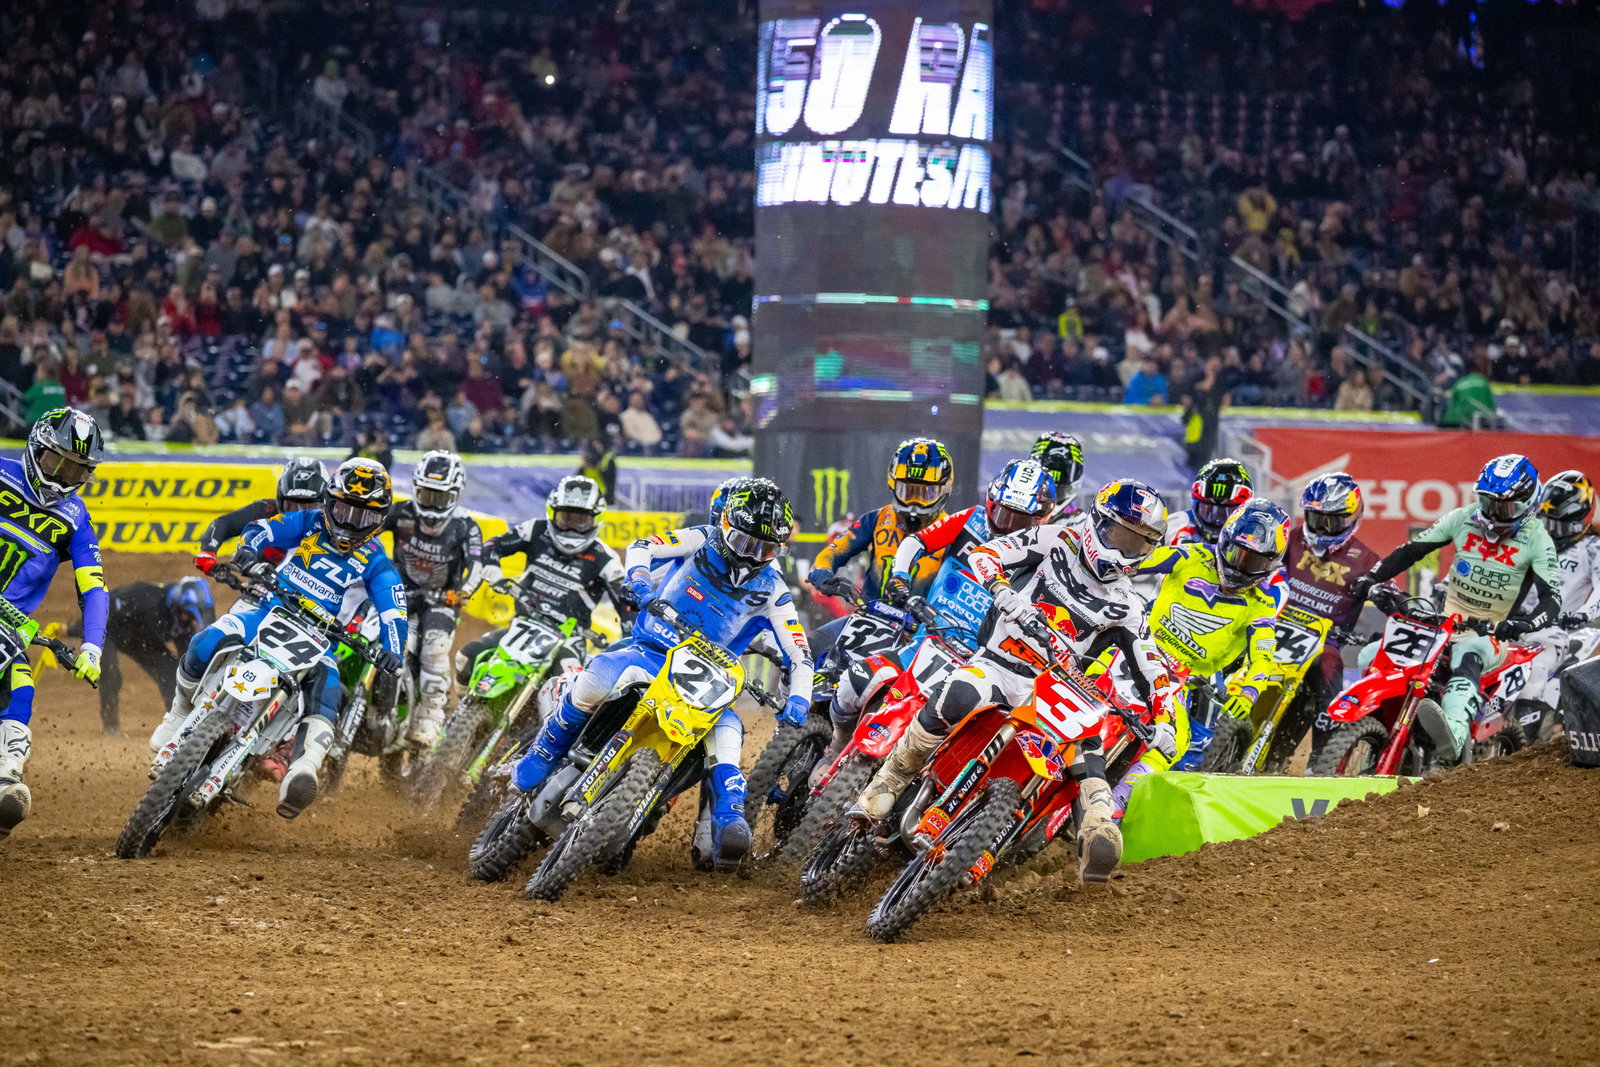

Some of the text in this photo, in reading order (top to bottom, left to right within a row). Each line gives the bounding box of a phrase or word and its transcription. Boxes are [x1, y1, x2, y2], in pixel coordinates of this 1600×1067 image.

[82, 478, 253, 498] DUNLOP
[0, 490, 68, 543] FXR
[92, 521, 203, 543] DUNL
[311, 557, 363, 589] FLY
[1472, 564, 1511, 583] QUAD
[1559, 558, 1578, 573] XR
[291, 565, 341, 603] Husqvarna
[961, 582, 994, 607] QUAD
[1289, 577, 1343, 604] PROGRESSIVE
[1452, 576, 1504, 601] HONDA
[1470, 574, 1511, 591] LOCK
[938, 595, 982, 626] HONDA
[957, 590, 989, 615] LOCK
[1288, 591, 1334, 614] SUZUKI
[259, 620, 323, 666] 24
[653, 623, 681, 643] SUZ
[841, 619, 897, 657] 32
[1159, 615, 1207, 660] HONDA
[1274, 625, 1310, 659] 94
[694, 640, 732, 669] RENTHA
[674, 659, 729, 708] 21
[1504, 666, 1527, 698] 28
[1036, 683, 1099, 740] 3
[219, 744, 242, 770] DUNLO
[581, 748, 617, 793] DUNLOP
